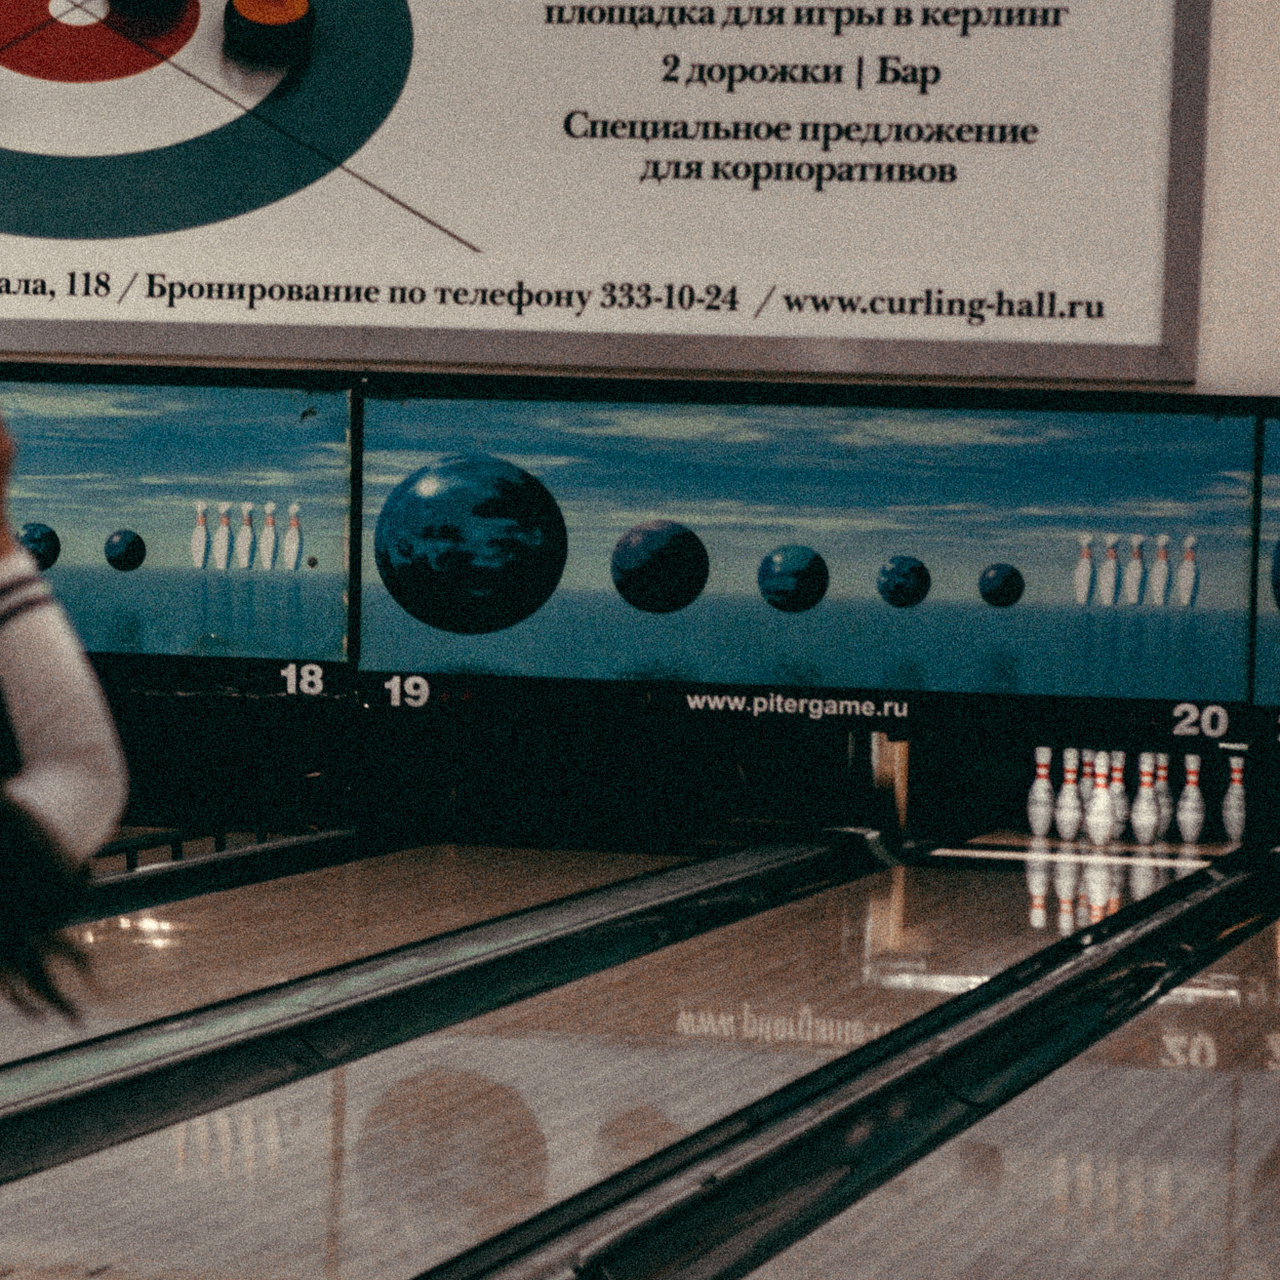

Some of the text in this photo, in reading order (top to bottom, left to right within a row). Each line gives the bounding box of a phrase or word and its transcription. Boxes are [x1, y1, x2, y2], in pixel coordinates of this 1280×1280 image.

[545, 5, 1070, 38] площадка для игры в керлинг
[661, 54, 681, 84] 2
[685, 58, 844, 94] дорожки
[876, 55, 942, 94] Бар
[563, 110, 1040, 151] Специальное предложение
[640, 160, 958, 192] для корпоративов
[65, 271, 111, 298] 118
[146, 272, 380, 306] Бронирование
[389, 287, 426, 306] по
[435, 280, 592, 315] телефону
[600, 282, 740, 313] 333-10-24
[783, 288, 1105, 326] www.curling-hall.ru
[280, 663, 324, 696] 18
[384, 675, 430, 708] 19
[686, 690, 910, 719] www.pitergame.ru
[1172, 702, 1229, 738] 20
